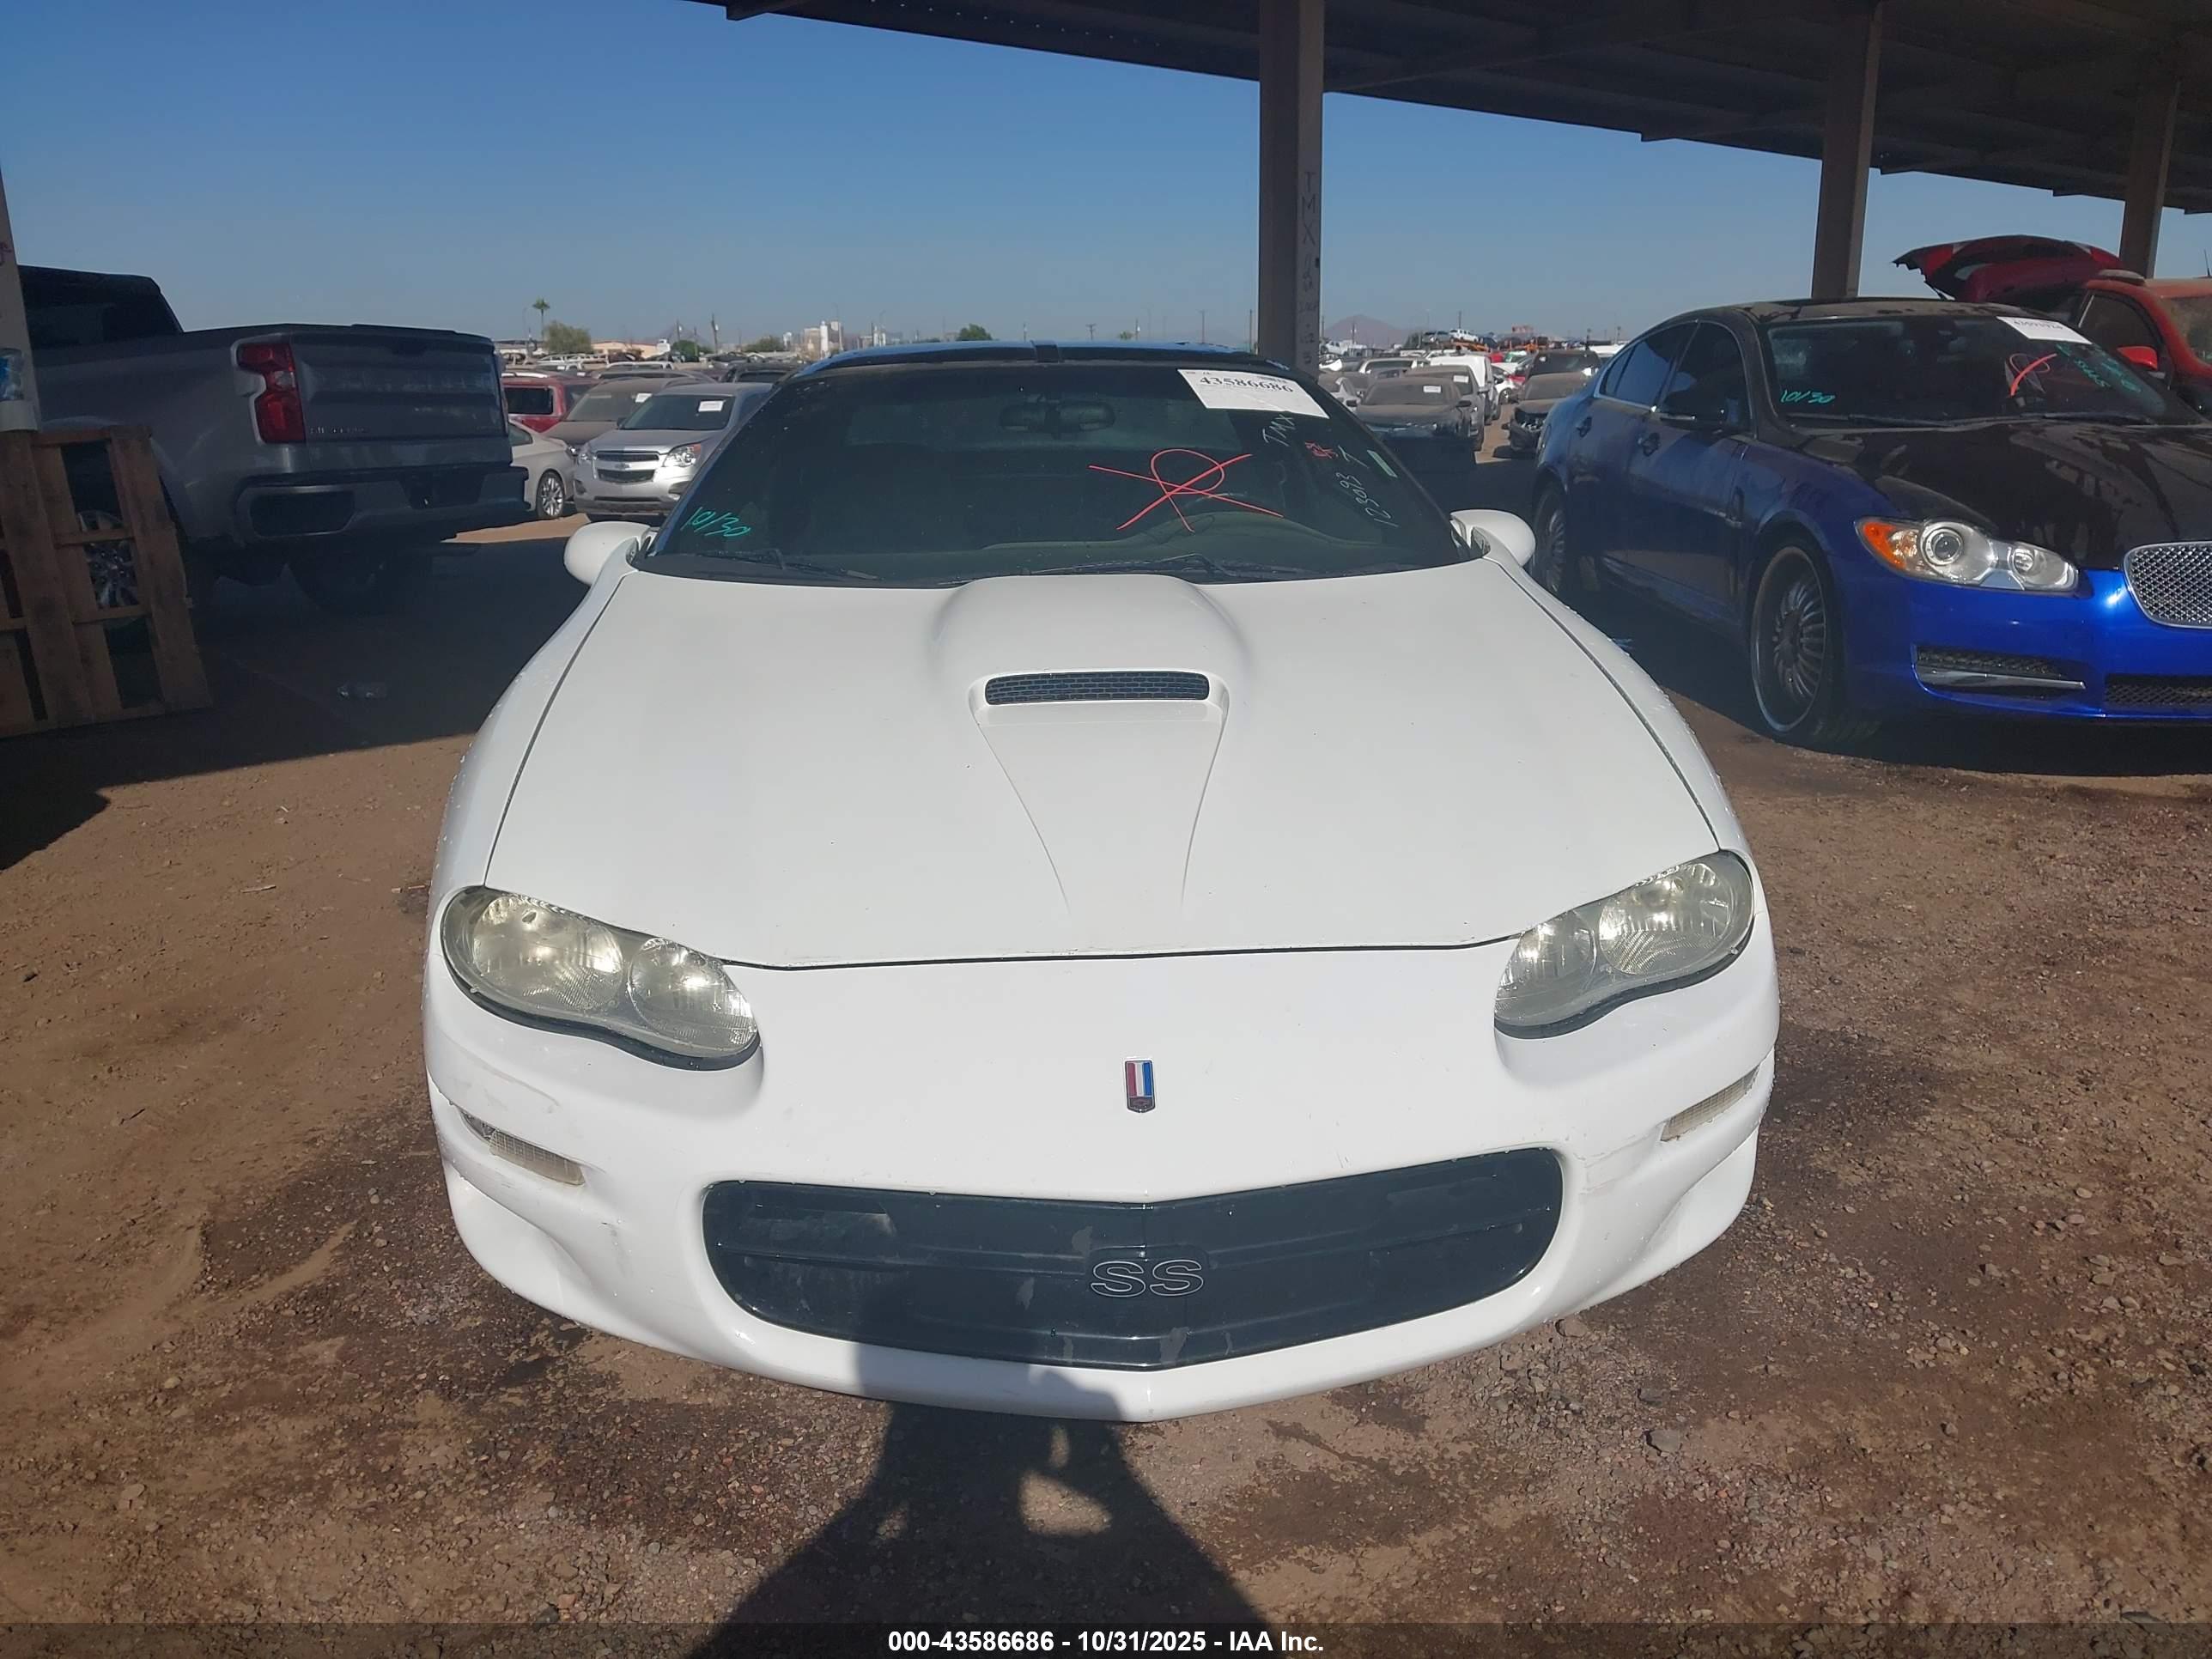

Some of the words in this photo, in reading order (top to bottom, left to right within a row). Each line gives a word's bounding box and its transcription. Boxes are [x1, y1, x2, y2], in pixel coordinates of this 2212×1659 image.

[1200, 376, 1294, 392] 43586686
[1780, 389, 1836, 404] 10/30
[680, 507, 751, 537] 10/30
[1091, 1259, 1204, 1297] SS
